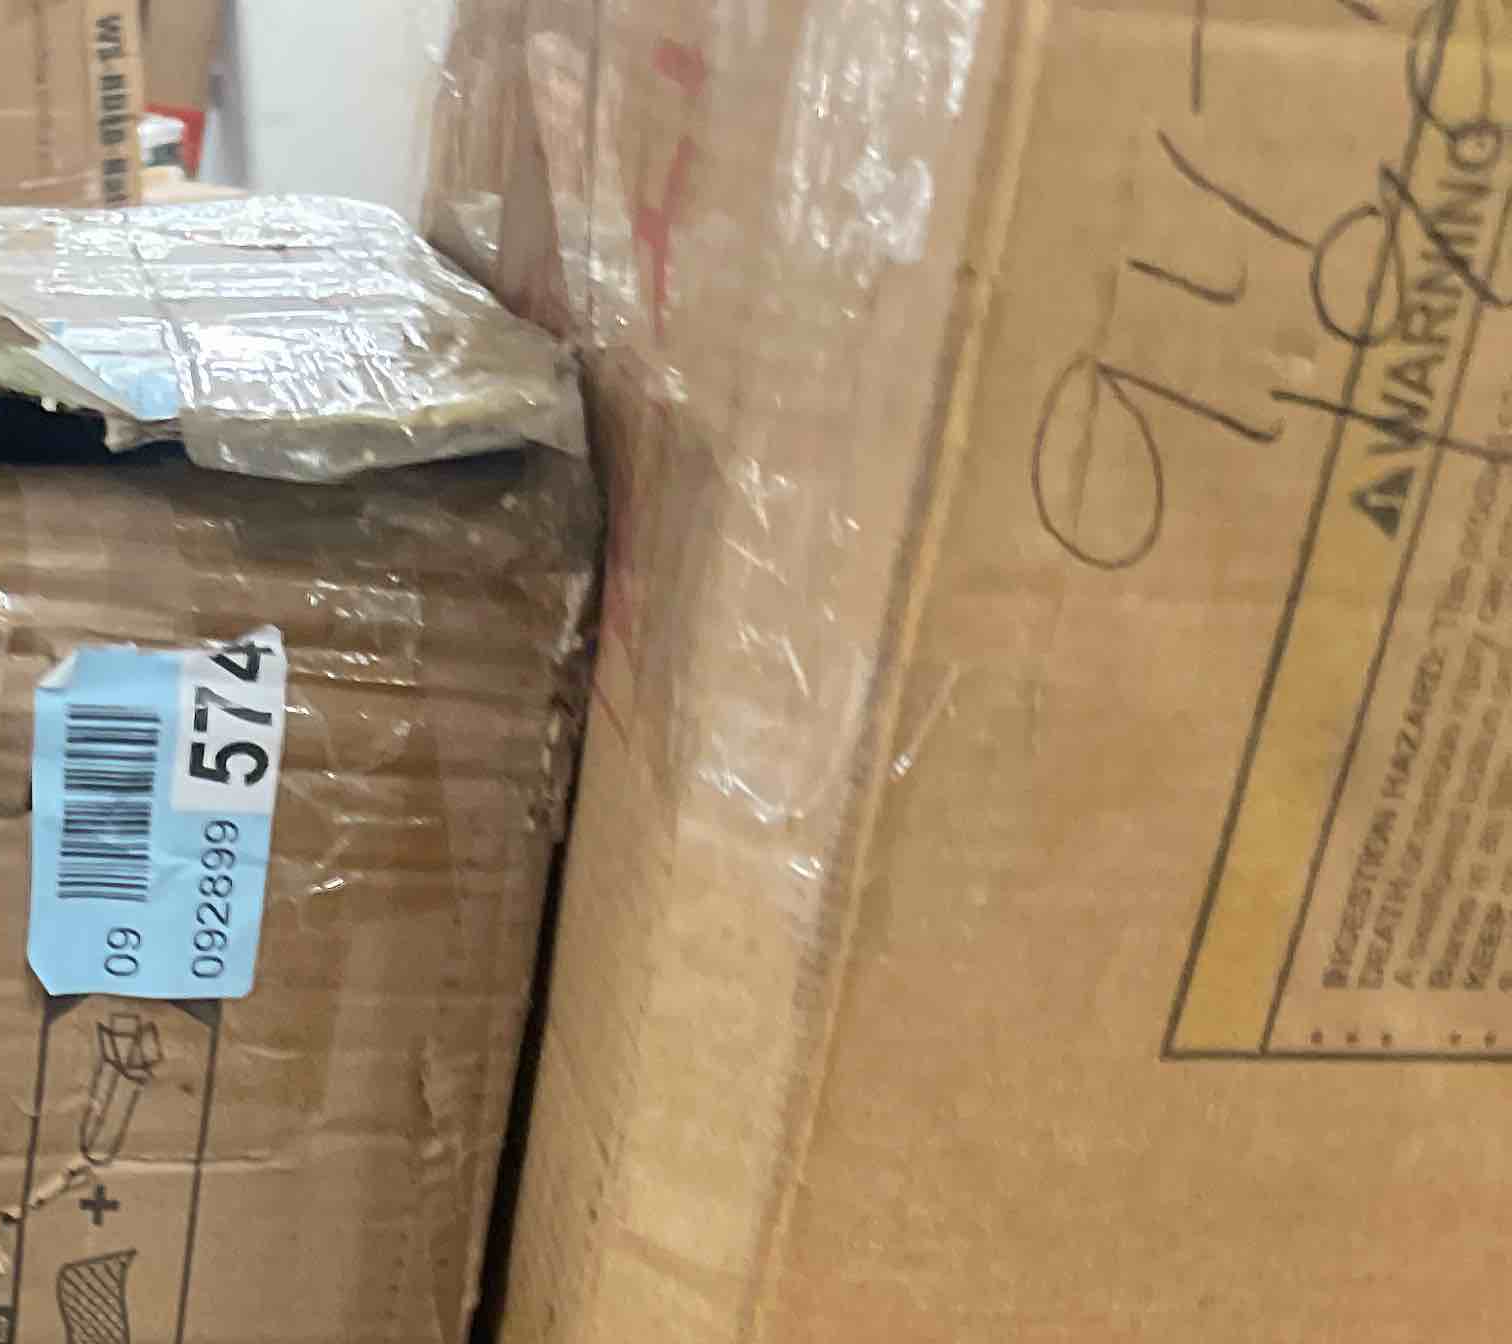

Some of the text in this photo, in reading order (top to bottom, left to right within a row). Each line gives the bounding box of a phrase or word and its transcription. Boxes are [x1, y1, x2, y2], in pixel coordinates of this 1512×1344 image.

[1369, 120, 1502, 457] WARNING
[188, 640, 275, 789] 574
[104, 926, 144, 977] 09
[190, 819, 240, 981] 092899
